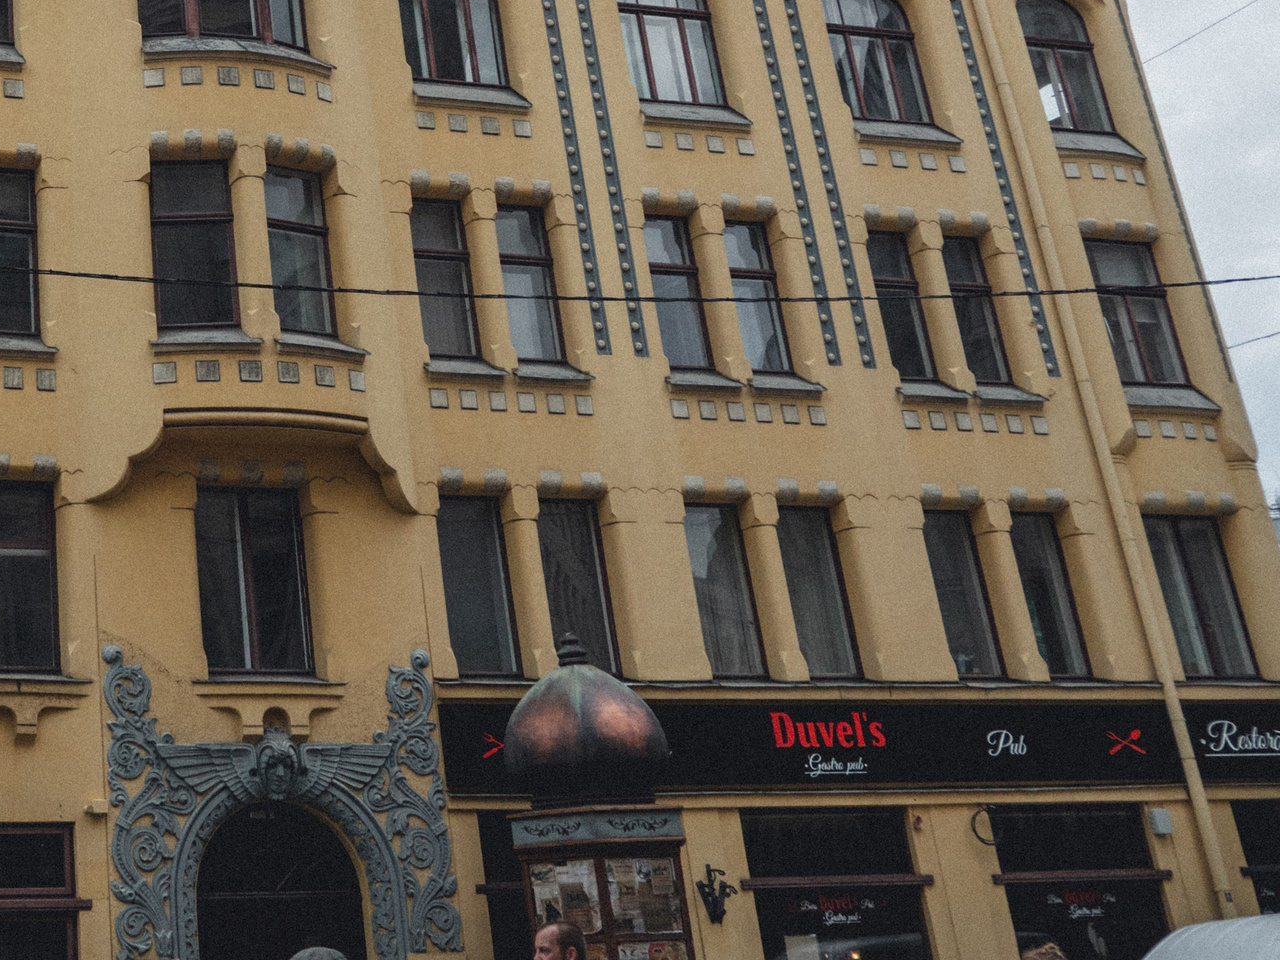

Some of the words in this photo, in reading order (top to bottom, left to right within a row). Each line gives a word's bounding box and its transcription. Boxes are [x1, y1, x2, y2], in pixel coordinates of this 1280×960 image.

[770, 711, 887, 748] Duvel's
[987, 730, 1027, 757] Pub
[807, 753, 843, 777] Gastro
[847, 757, 864, 775] pub
